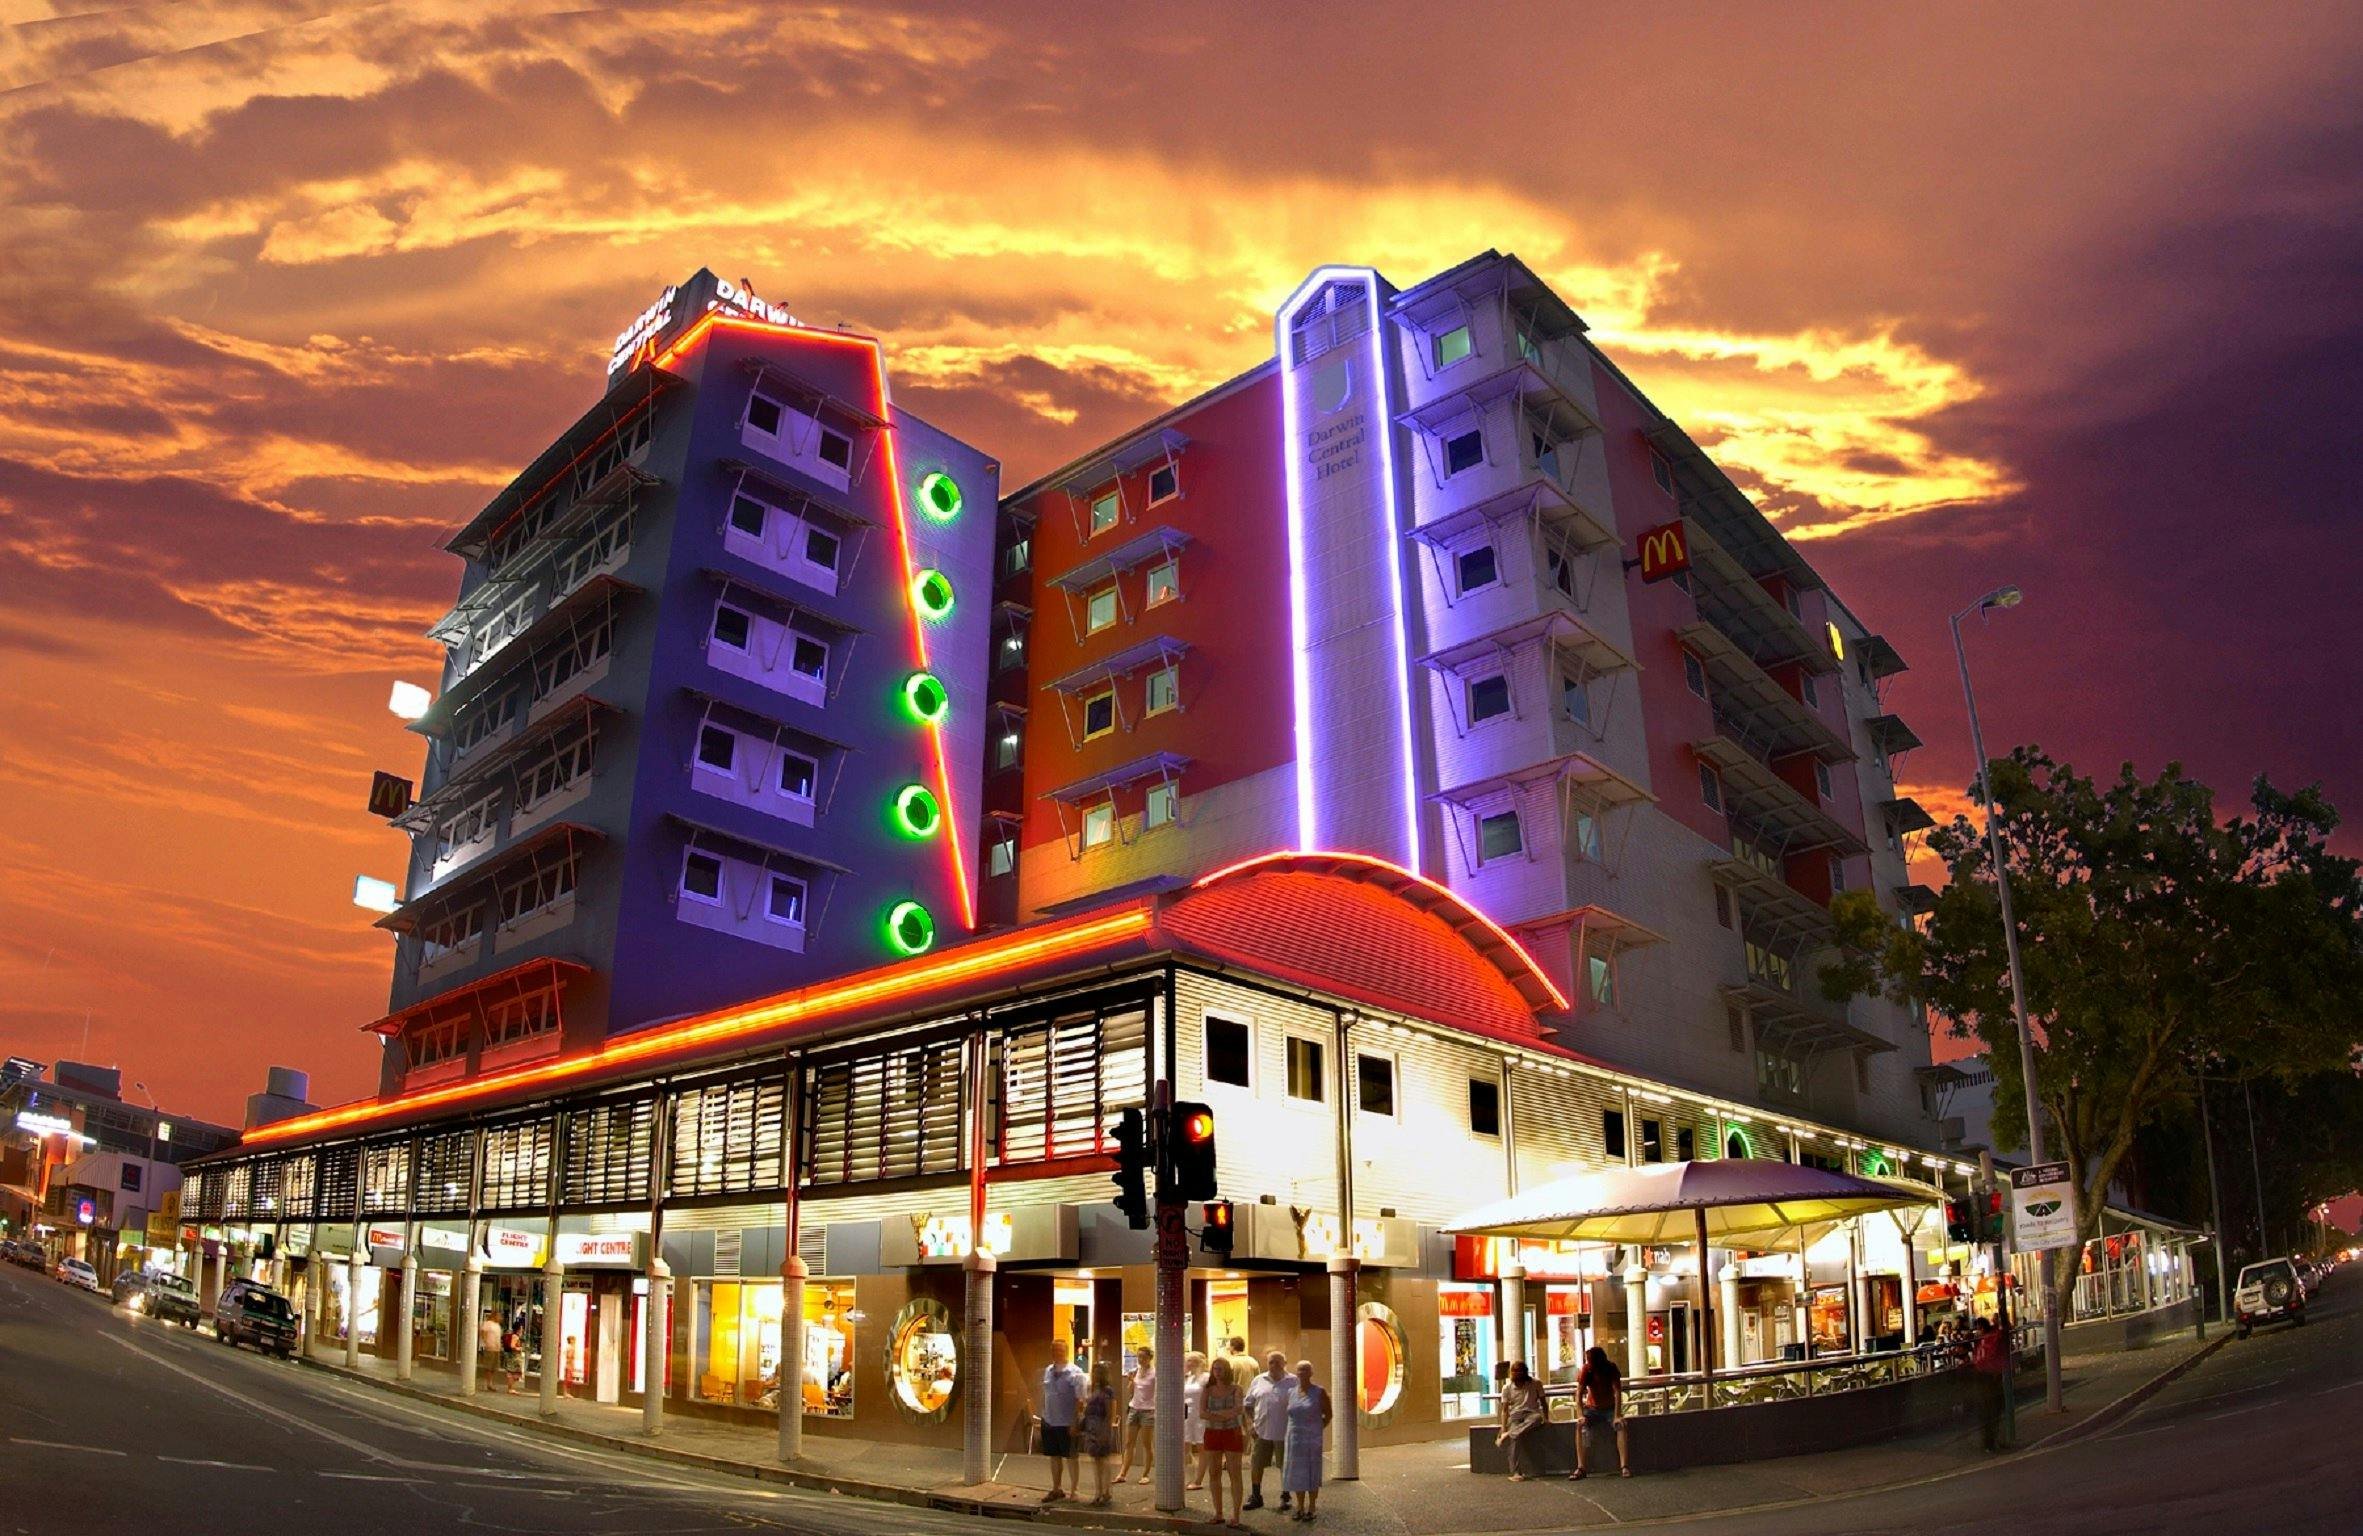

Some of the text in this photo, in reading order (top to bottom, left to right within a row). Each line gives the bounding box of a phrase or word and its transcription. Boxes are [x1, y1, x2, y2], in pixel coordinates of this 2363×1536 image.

[1308, 414, 1364, 447] Darwin
[1308, 428, 1365, 463] Central
[1317, 449, 1360, 480] Hotel
[500, 1238, 529, 1248] CENTRE
[600, 1240, 632, 1255] CENTRE
[1654, 1247, 1671, 1265] nab
